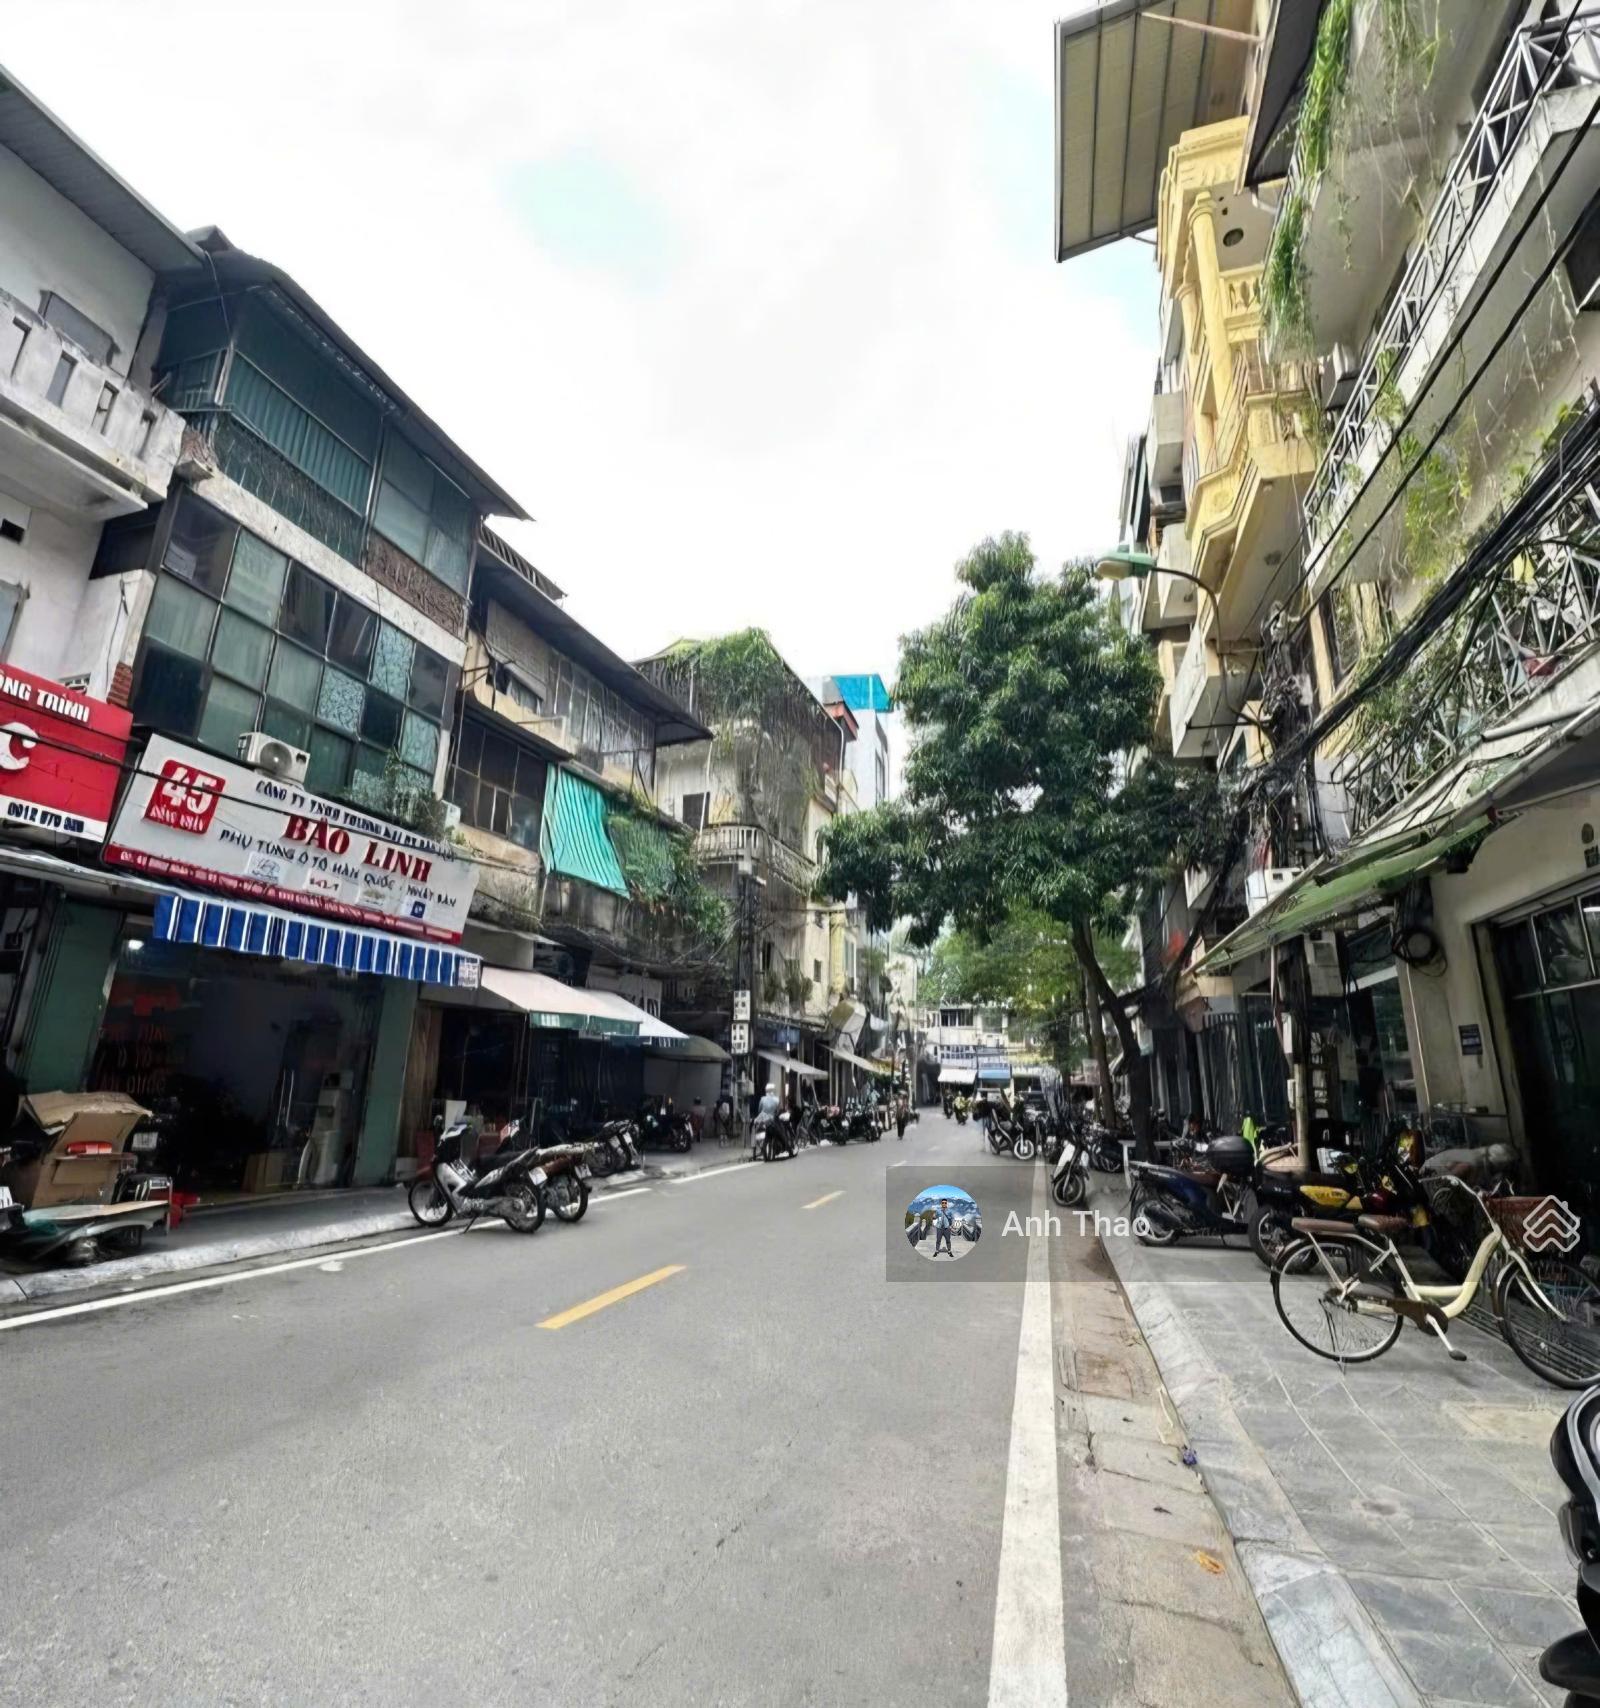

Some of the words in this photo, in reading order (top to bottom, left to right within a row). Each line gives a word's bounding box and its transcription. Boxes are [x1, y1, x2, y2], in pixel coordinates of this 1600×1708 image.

[0, 670, 32, 702] NG
[162, 766, 217, 815] 45
[219, 829, 252, 850] PHỤ
[363, 871, 395, 890] QUỐC
[282, 815, 350, 855] BẢO
[362, 840, 432, 883] LINH
